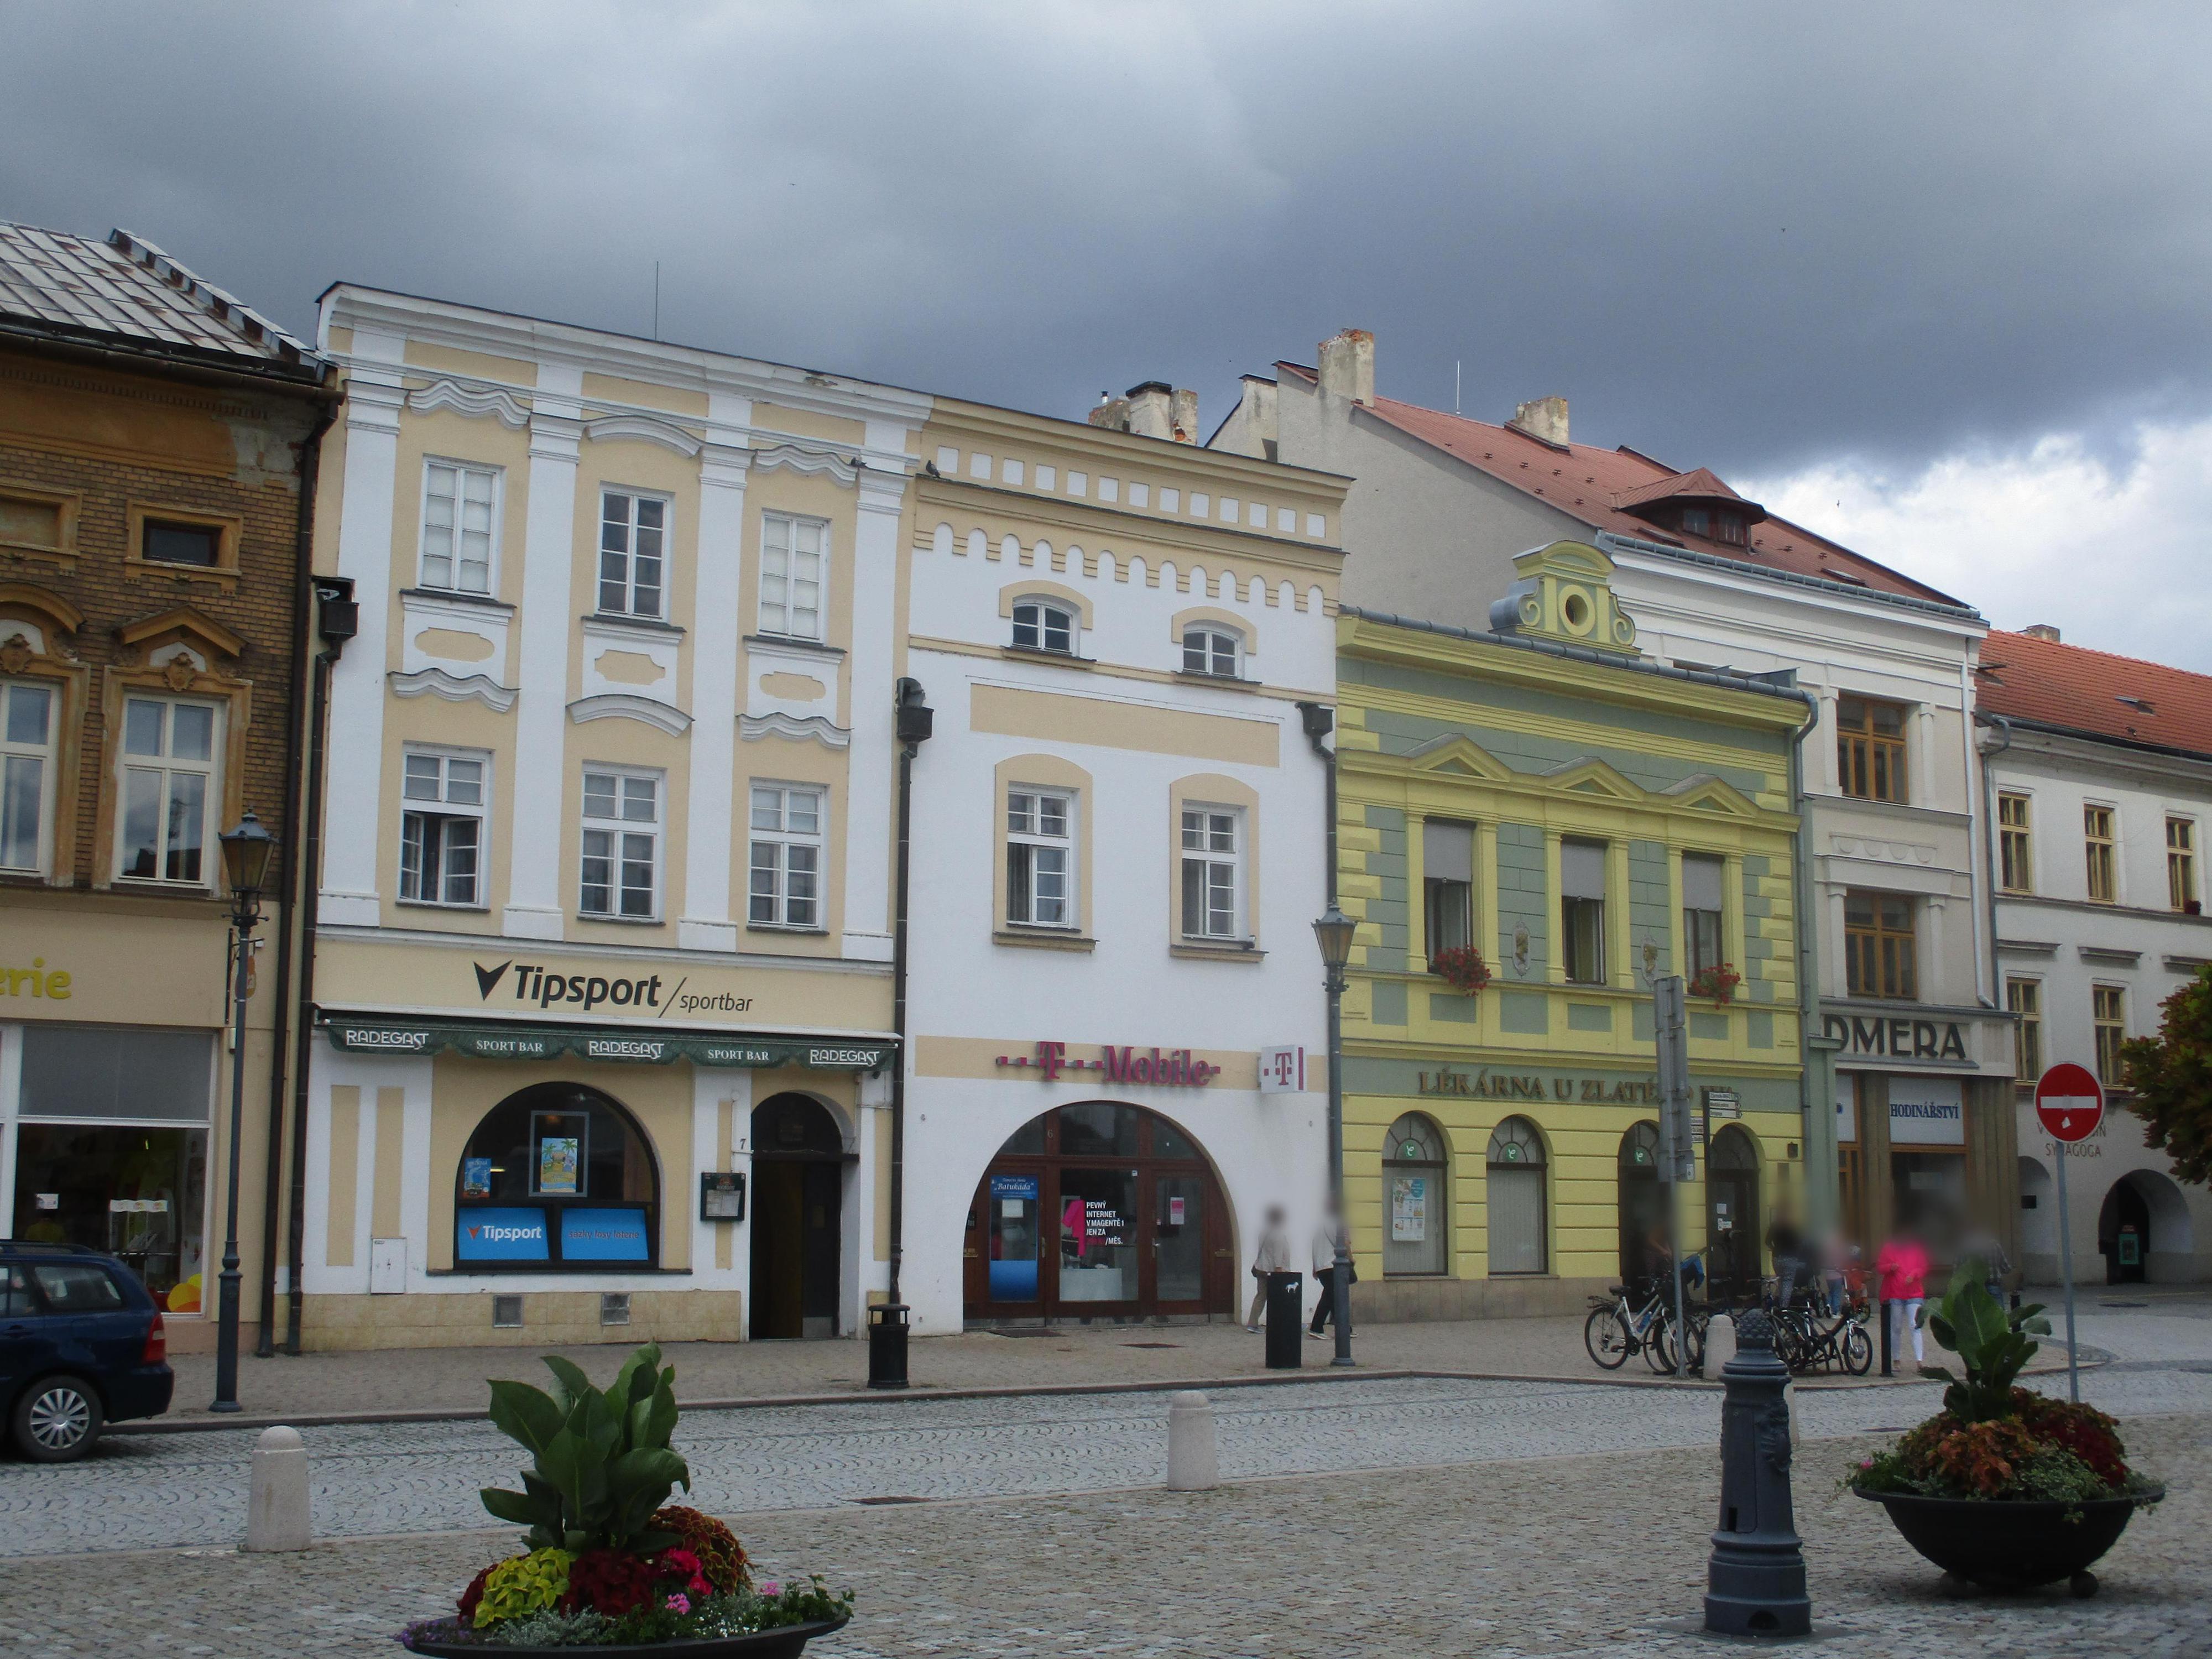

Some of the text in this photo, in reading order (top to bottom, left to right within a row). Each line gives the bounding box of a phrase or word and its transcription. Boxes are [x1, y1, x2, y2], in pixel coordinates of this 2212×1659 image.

[0, 956, 72, 999] rie
[514, 965, 661, 1011] Tipsport
[346, 1030, 429, 1050] RADEGAST
[476, 1040, 544, 1052] SPORT BAR
[589, 1040, 664, 1060] RADEGAST
[708, 1049, 769, 1061] SPORT BAR
[810, 1049, 879, 1067] RADEGAST
[1418, 1065, 1547, 1098] LÉKÁRNA
[1554, 1078, 1574, 1099] U
[1890, 1102, 1959, 1119] HODINÁŘSTVÍ
[1047, 1129, 1053, 1138] 6
[740, 1138, 747, 1150] 7
[2046, 1142, 2102, 1157] SYAGOGA
[1086, 1200, 1107, 1209] PEVNÝ
[1091, 1218, 1120, 1227] MAGENTĚ
[483, 1225, 542, 1242] Tipsport
